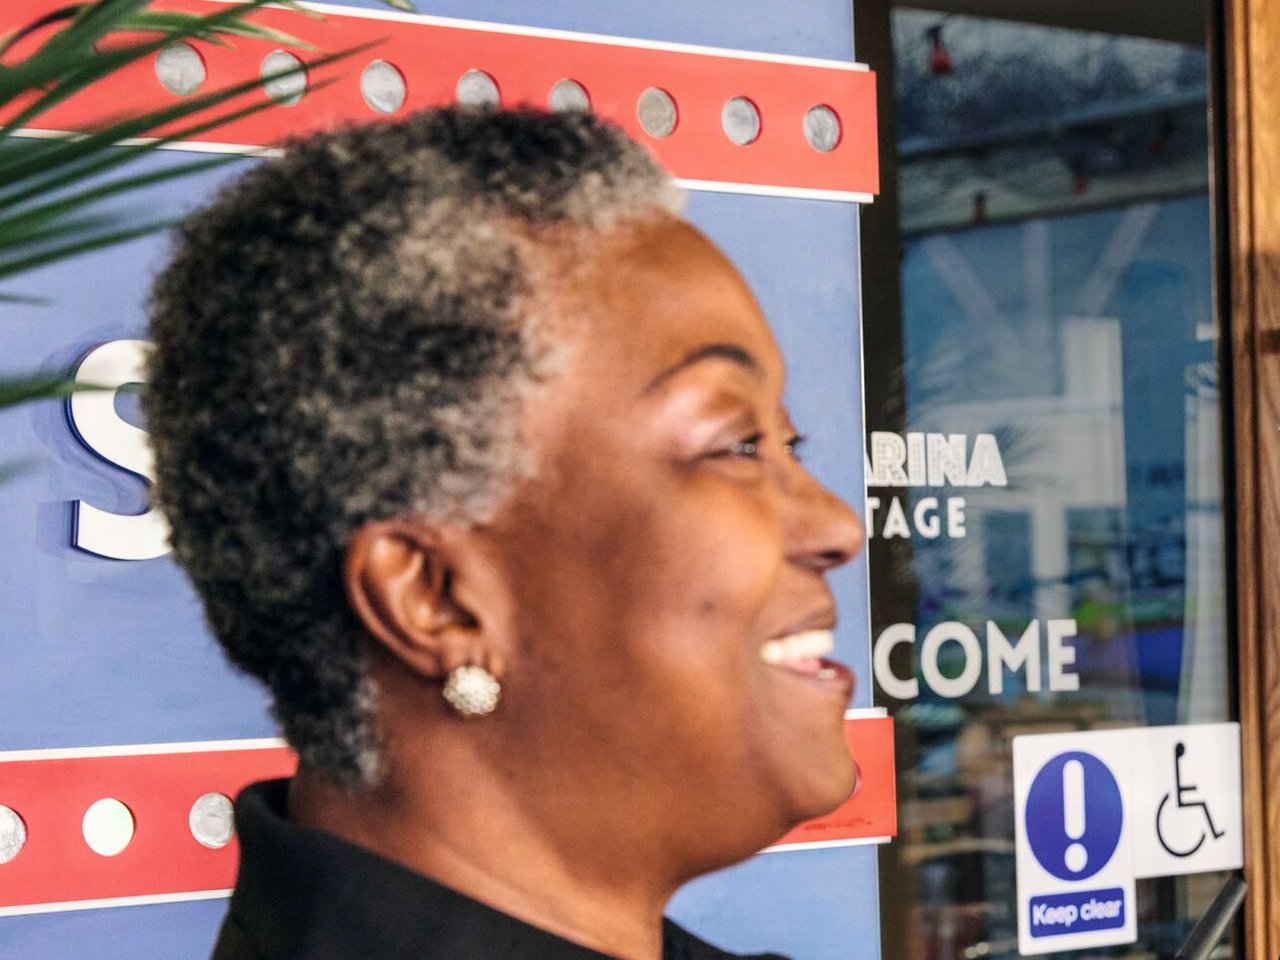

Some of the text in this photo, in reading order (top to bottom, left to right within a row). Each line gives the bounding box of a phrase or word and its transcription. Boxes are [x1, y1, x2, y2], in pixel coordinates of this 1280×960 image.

[873, 618, 1080, 699] COME
[1032, 898, 1122, 927] Keep clear
